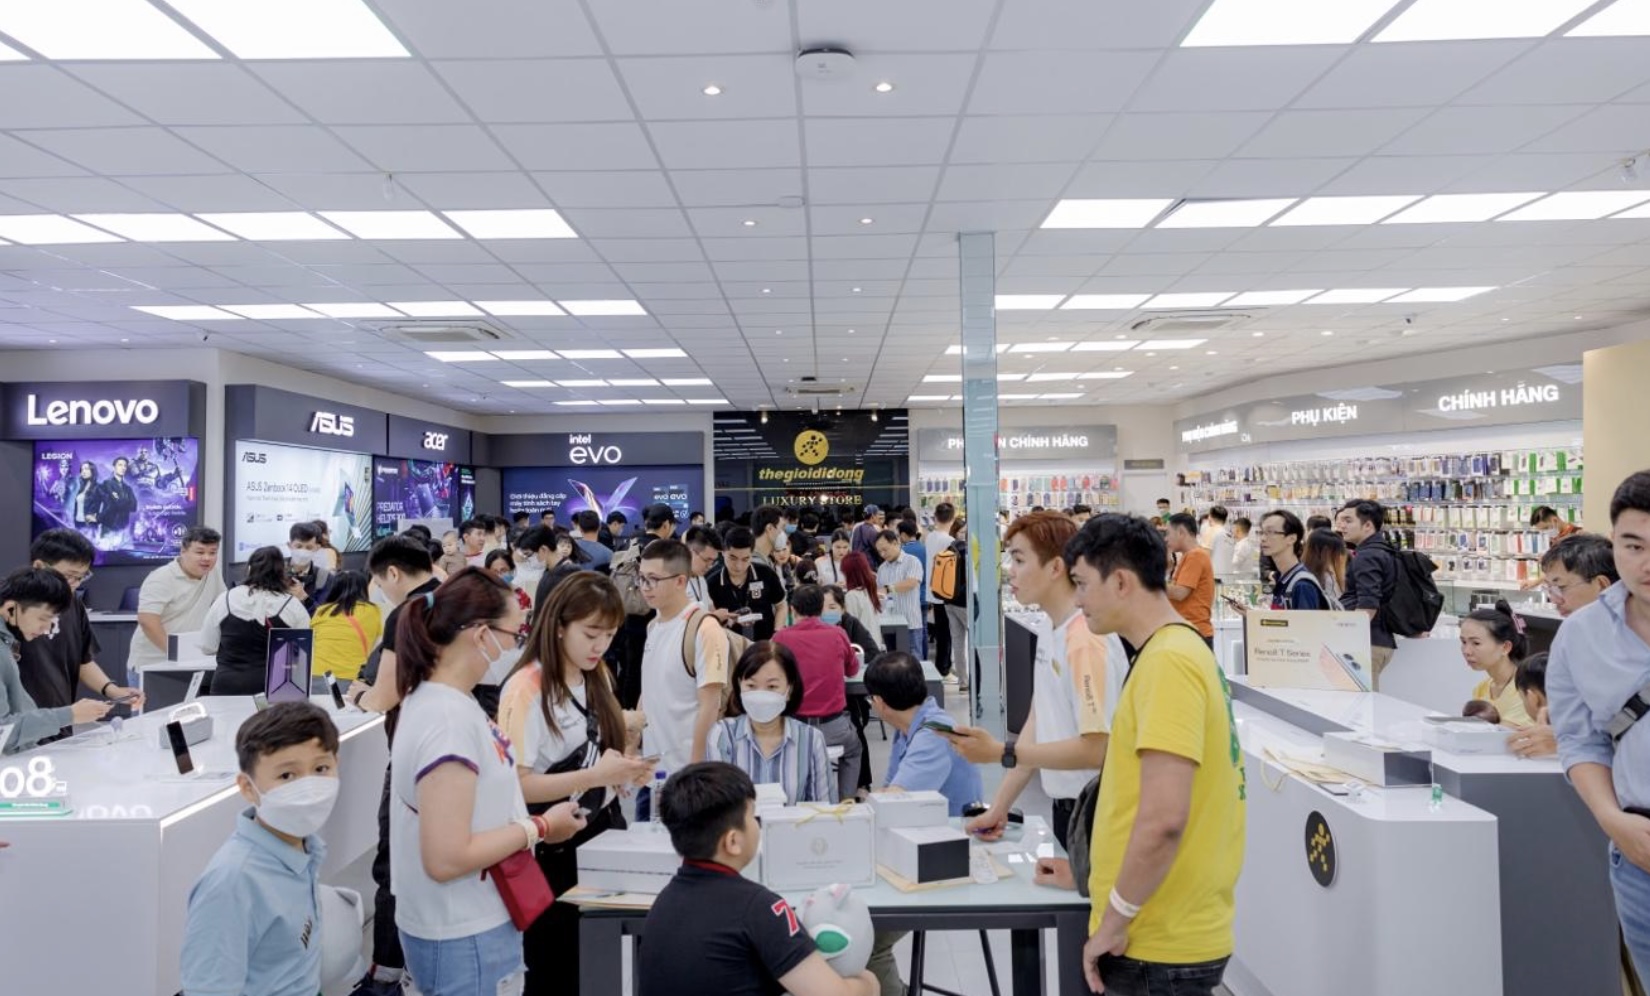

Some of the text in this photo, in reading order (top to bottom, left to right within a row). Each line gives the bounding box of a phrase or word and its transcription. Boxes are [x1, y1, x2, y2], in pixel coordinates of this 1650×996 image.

[27, 394, 159, 425] Lenovo
[1291, 382, 1560, 426] PHỤ KIỆN CHÍNH HÃNG
[310, 411, 355, 437] ASUS
[423, 431, 449, 451] acer
[569, 434, 592, 444] intel
[1009, 435, 1049, 448] CHÍNH
[242, 451, 267, 464] ASUS
[569, 445, 622, 465] evo
[759, 467, 864, 484] thegioididong
[246, 481, 262, 492] ASUS
[375, 501, 404, 512] PREDATOR
[762, 494, 863, 506] LUXURY STORE
[771, 898, 800, 937] 7
